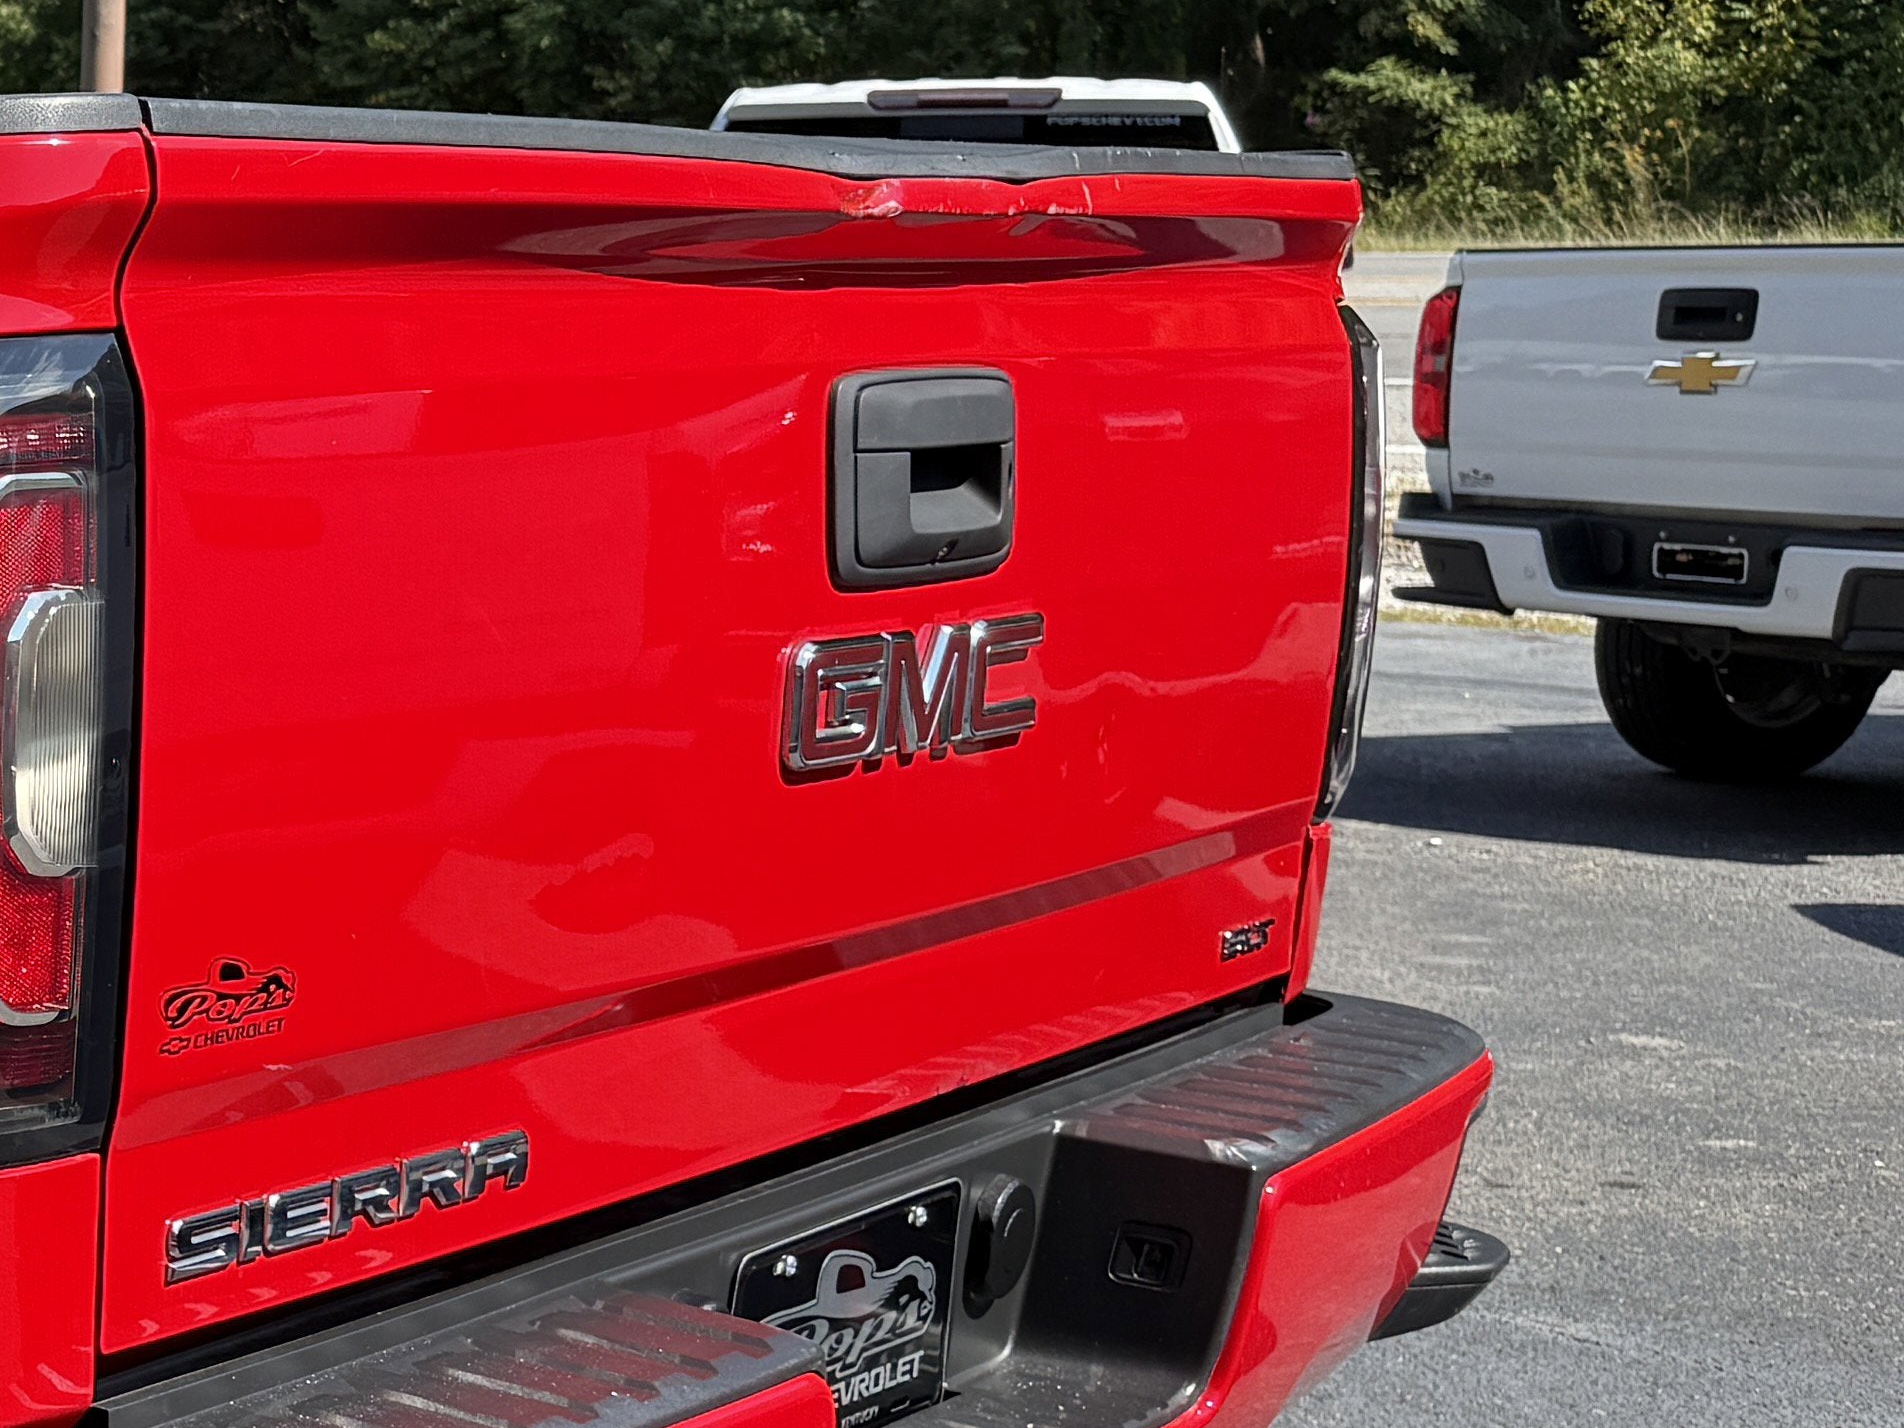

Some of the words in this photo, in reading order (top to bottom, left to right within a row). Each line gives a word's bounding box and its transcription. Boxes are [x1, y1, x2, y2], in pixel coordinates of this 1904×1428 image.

[784, 611, 1045, 778] GMC
[192, 1017, 286, 1049] CHEVROLET
[164, 1129, 529, 1287] SIERRA
